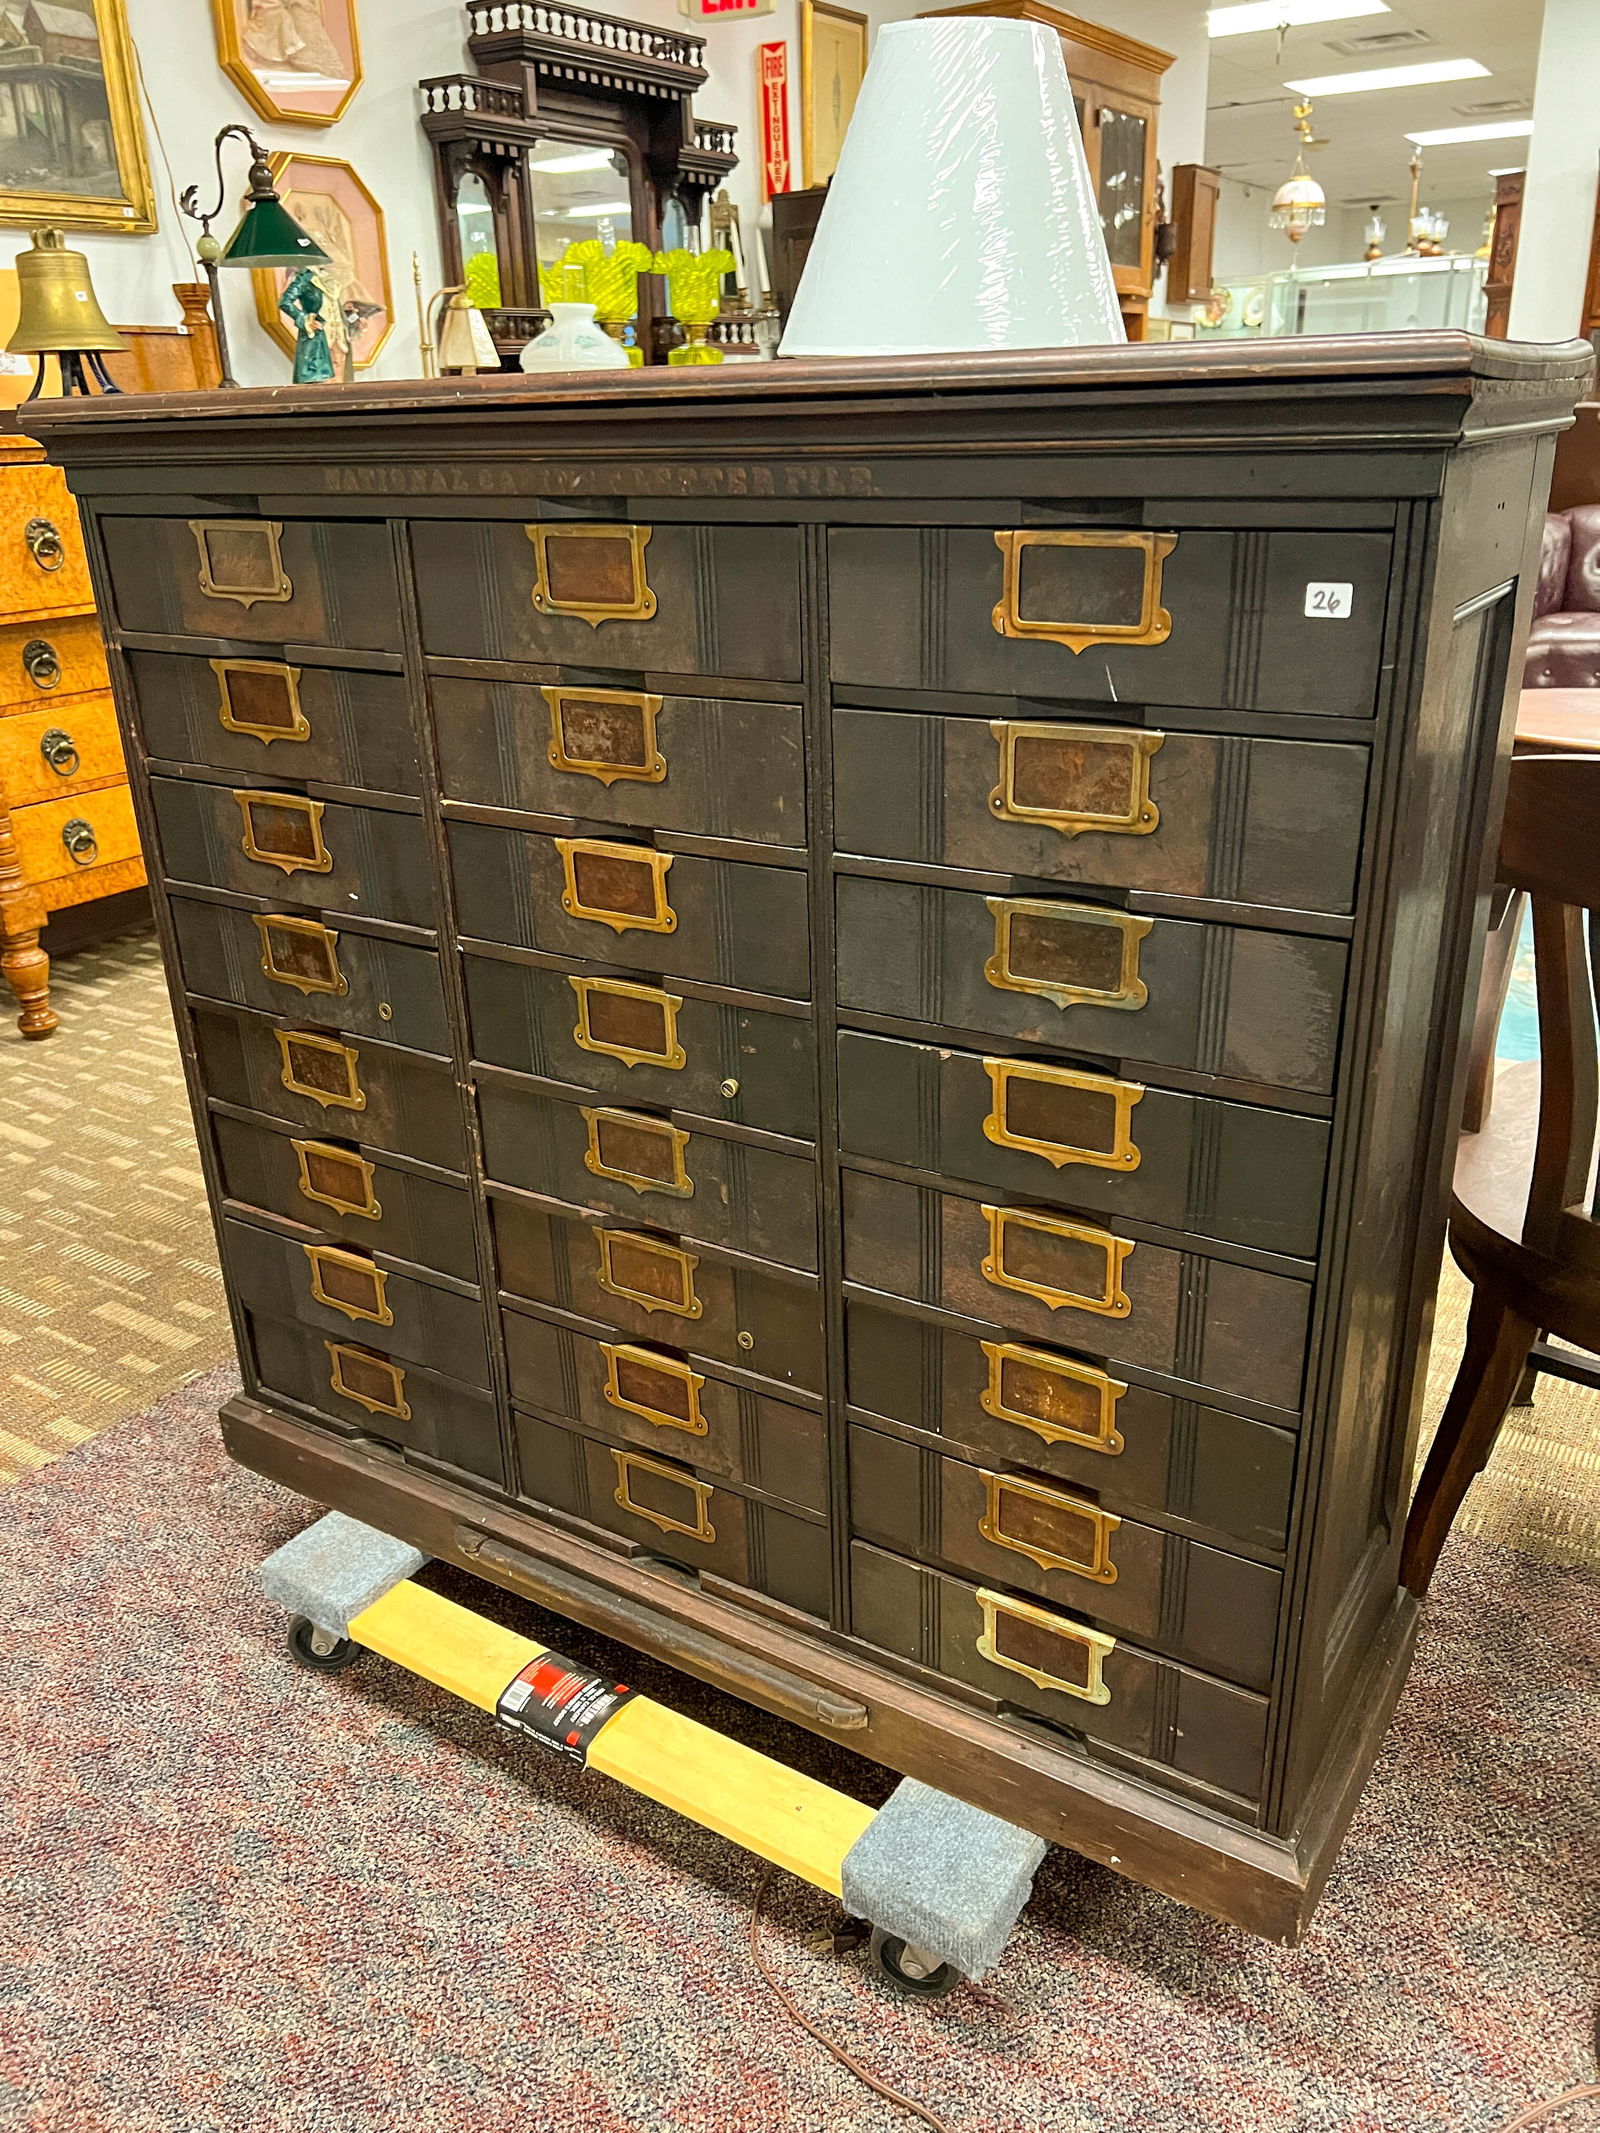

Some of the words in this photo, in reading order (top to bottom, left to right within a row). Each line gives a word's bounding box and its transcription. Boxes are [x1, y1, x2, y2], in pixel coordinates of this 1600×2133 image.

[766, 55, 783, 79] FIRE
[771, 82, 783, 184] EXTINGUISHER
[324, 467, 469, 492] NATIONAL
[1312, 590, 1341, 614] 26
